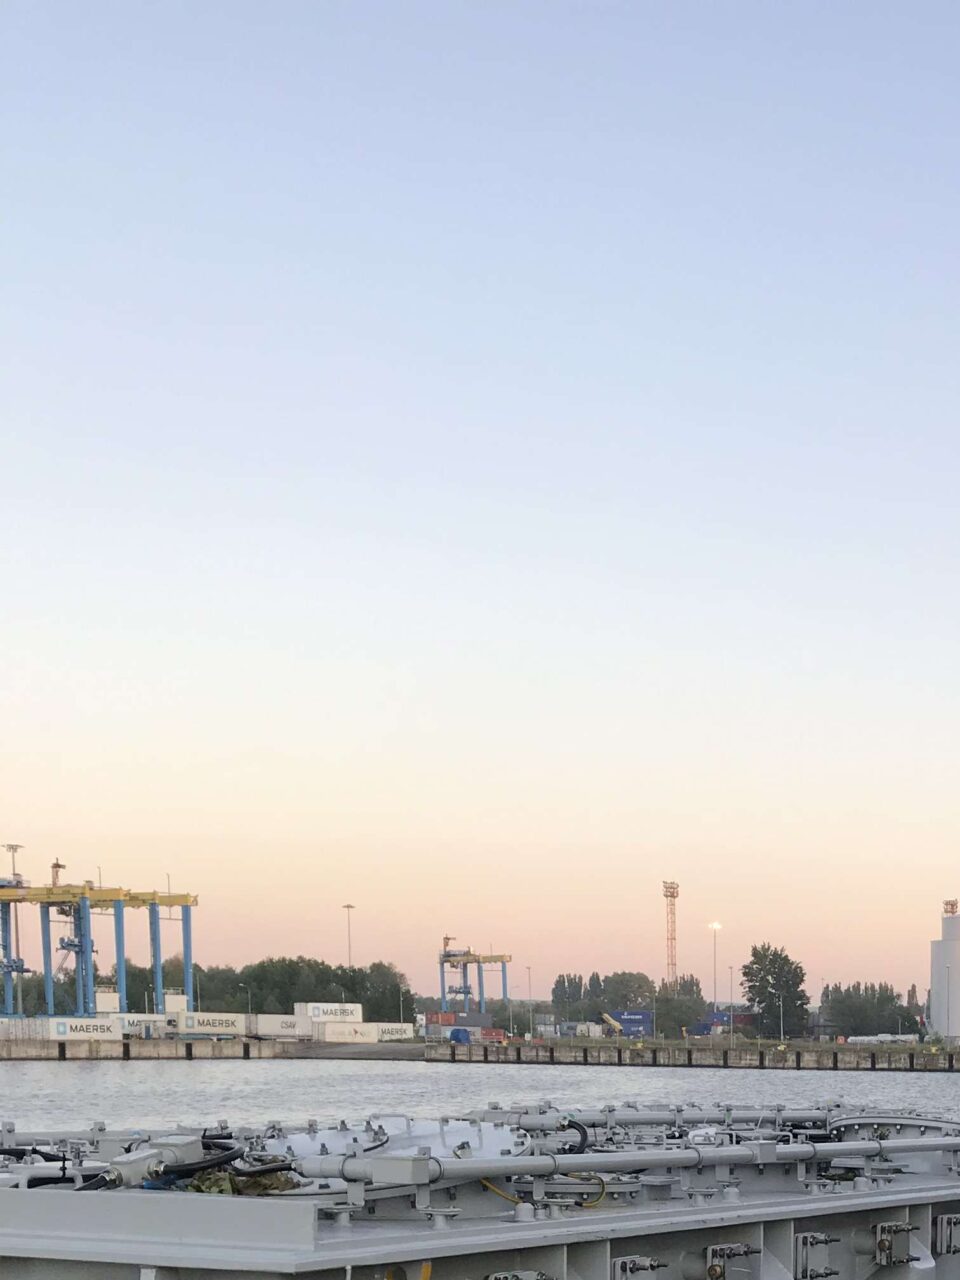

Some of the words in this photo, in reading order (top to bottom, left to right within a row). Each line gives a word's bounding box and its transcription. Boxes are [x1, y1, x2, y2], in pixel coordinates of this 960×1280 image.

[322, 1008, 355, 1016] MAERSK
[70, 1023, 112, 1033] MAERSK
[197, 1019, 237, 1028] MAERSK
[381, 1027, 407, 1036] MAERSK
